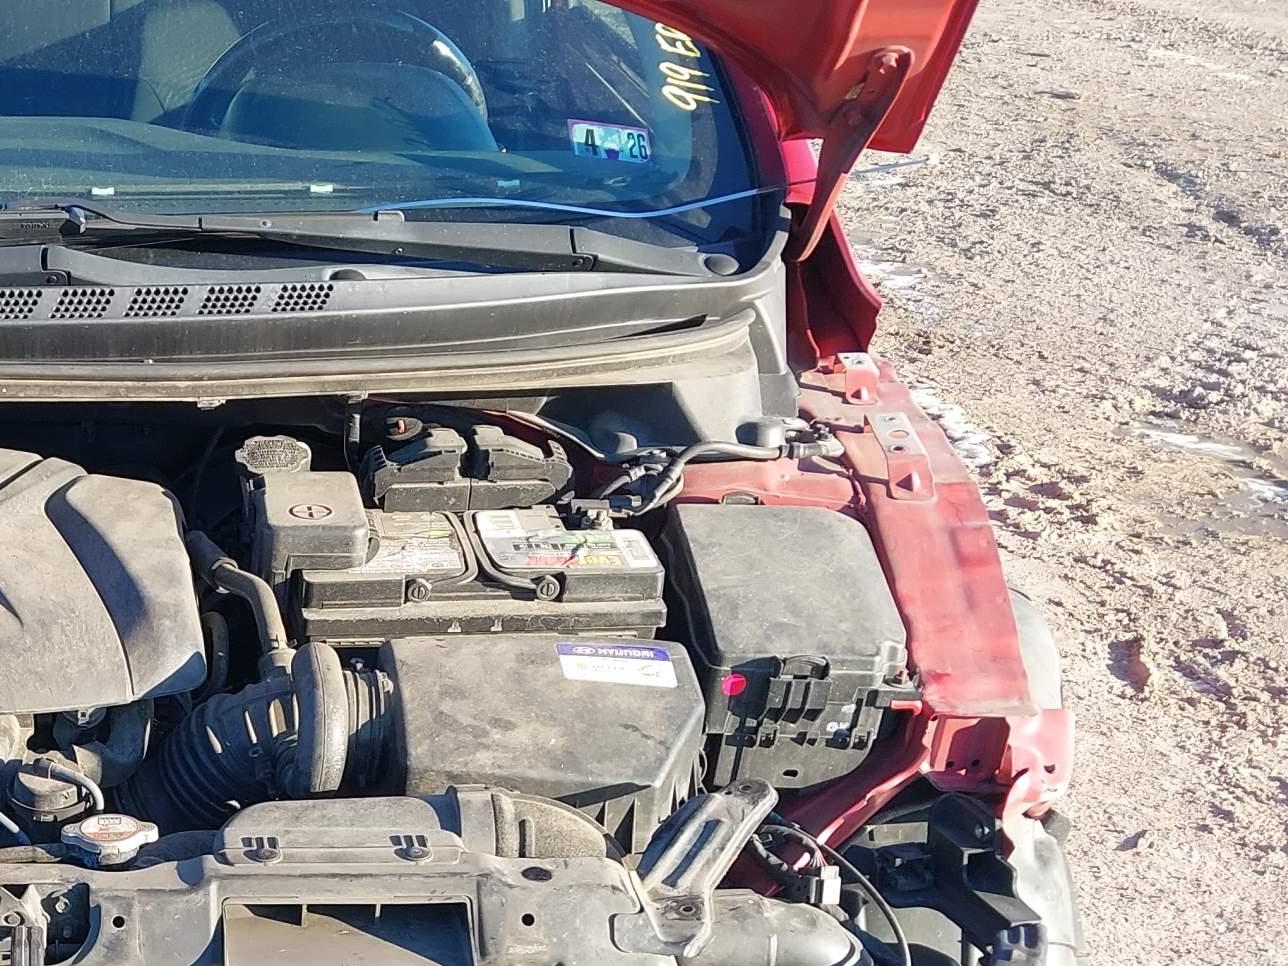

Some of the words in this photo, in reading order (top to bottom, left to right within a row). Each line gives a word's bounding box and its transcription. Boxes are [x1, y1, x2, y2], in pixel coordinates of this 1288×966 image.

[584, 128, 599, 156] 4
[627, 132, 649, 160] 26
[598, 648, 655, 658] HYUNDAI
